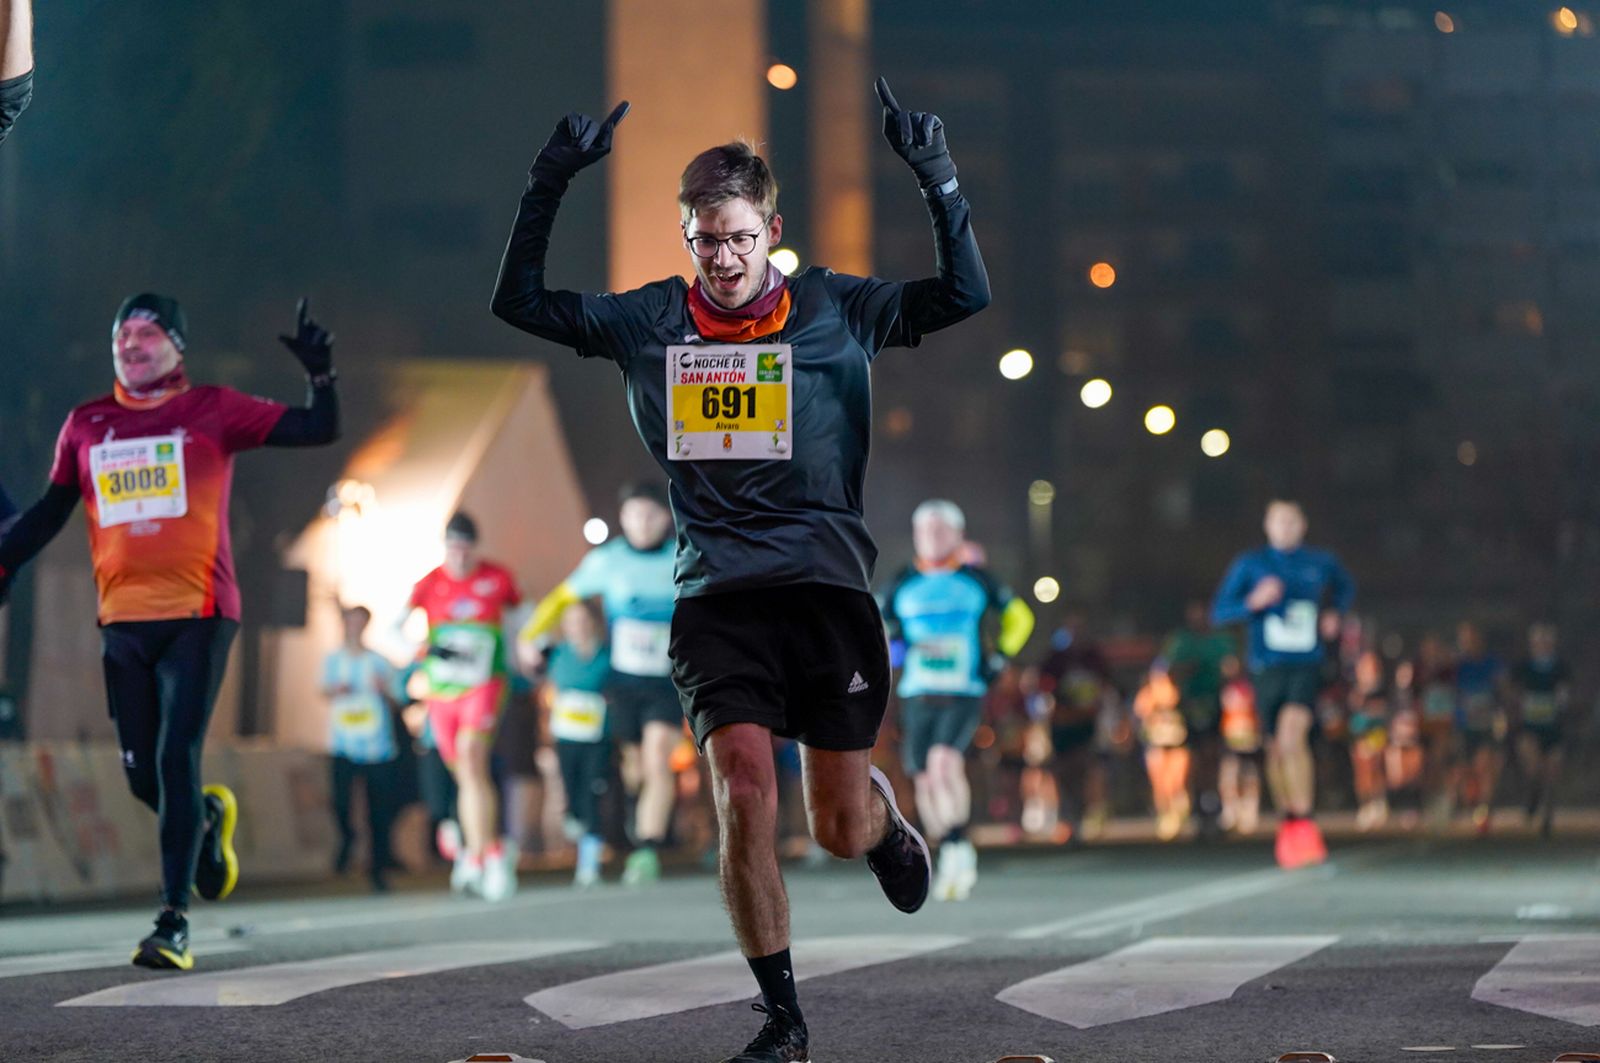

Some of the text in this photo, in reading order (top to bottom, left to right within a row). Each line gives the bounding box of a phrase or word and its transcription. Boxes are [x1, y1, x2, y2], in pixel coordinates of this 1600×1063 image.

[694, 358, 746, 368] NOCHE DE
[681, 368, 746, 384] SAN ANTÓN
[702, 386, 756, 419] 691
[109, 466, 167, 494] 3008
